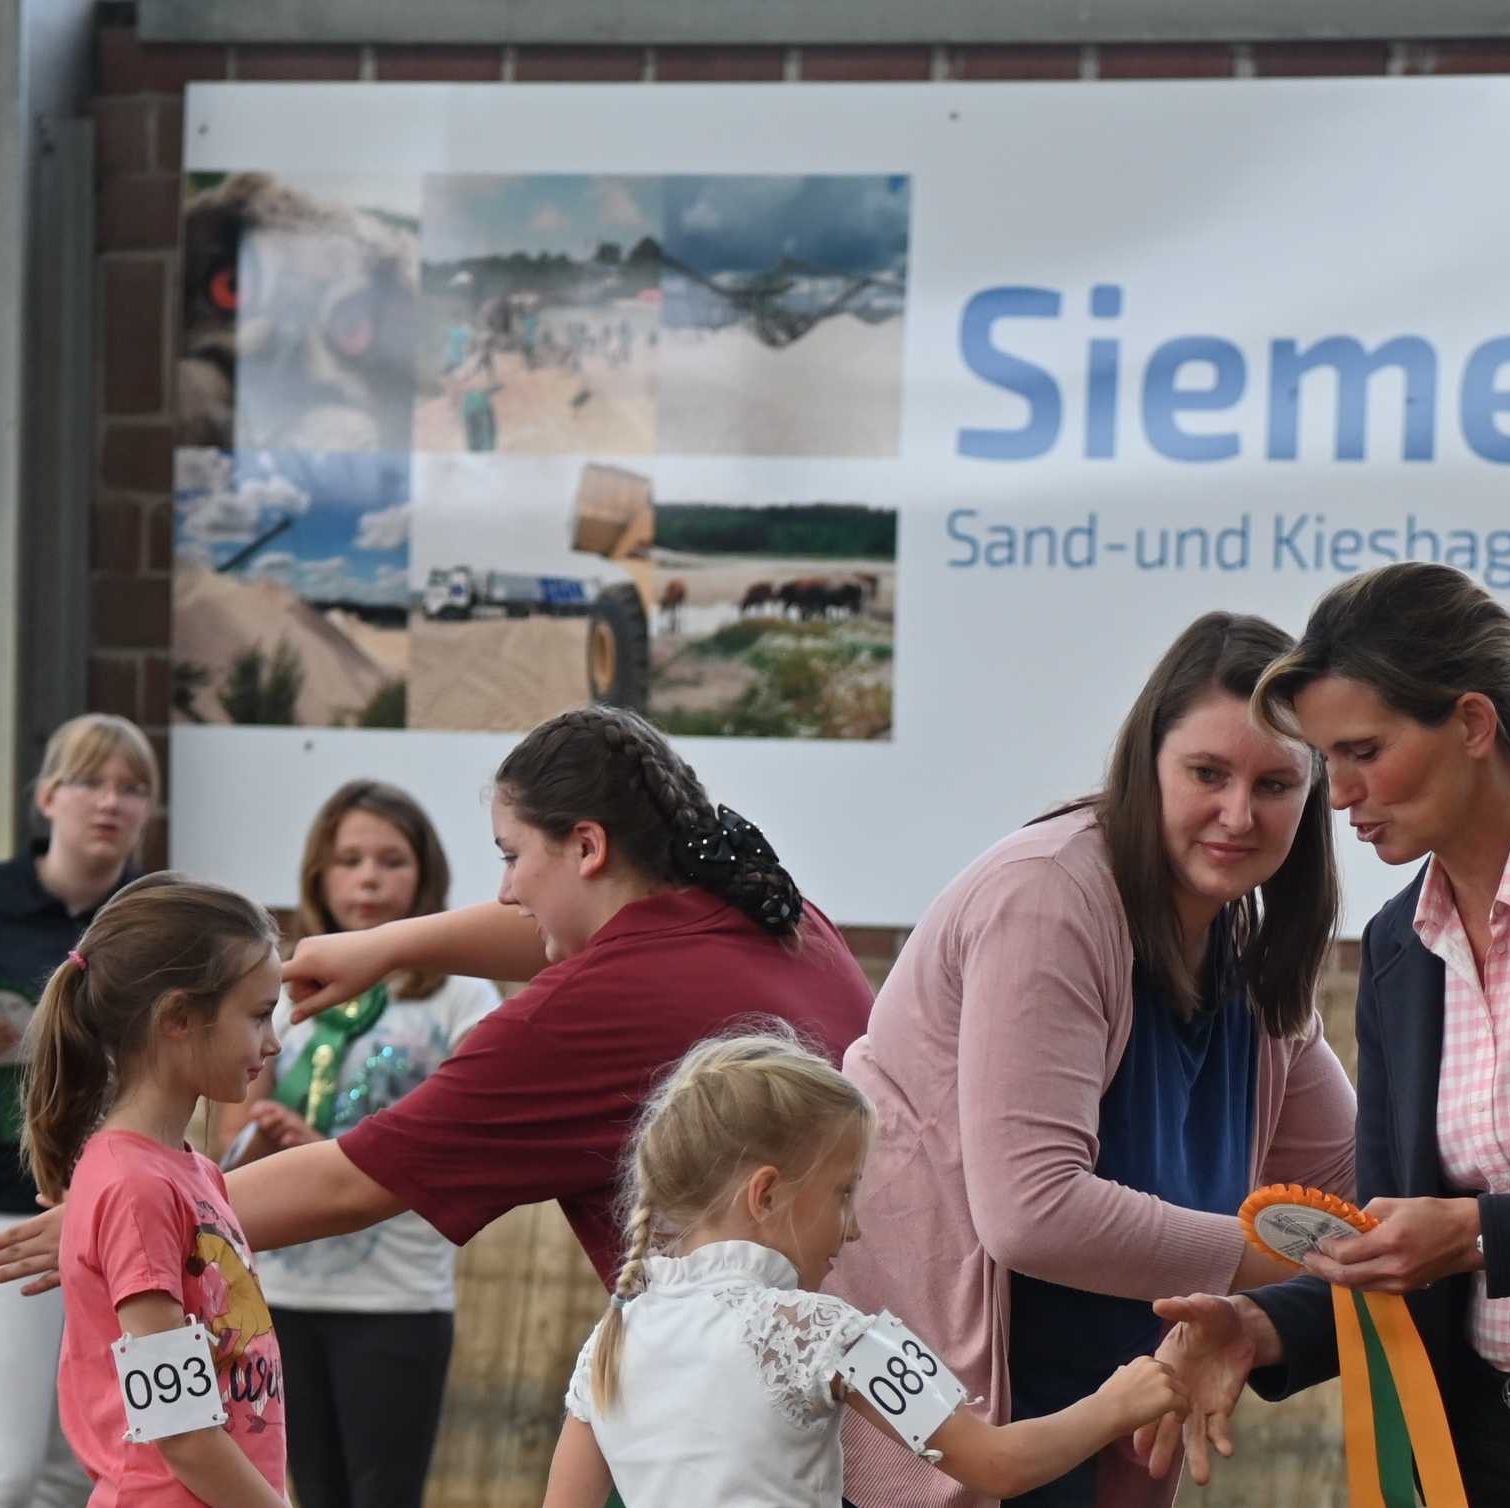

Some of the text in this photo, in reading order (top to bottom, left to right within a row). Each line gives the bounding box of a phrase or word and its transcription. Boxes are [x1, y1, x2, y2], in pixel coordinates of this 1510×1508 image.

[946, 508, 1251, 572] Sand-und
[124, 1356, 213, 1411] 093
[868, 1339, 939, 1417] 083
